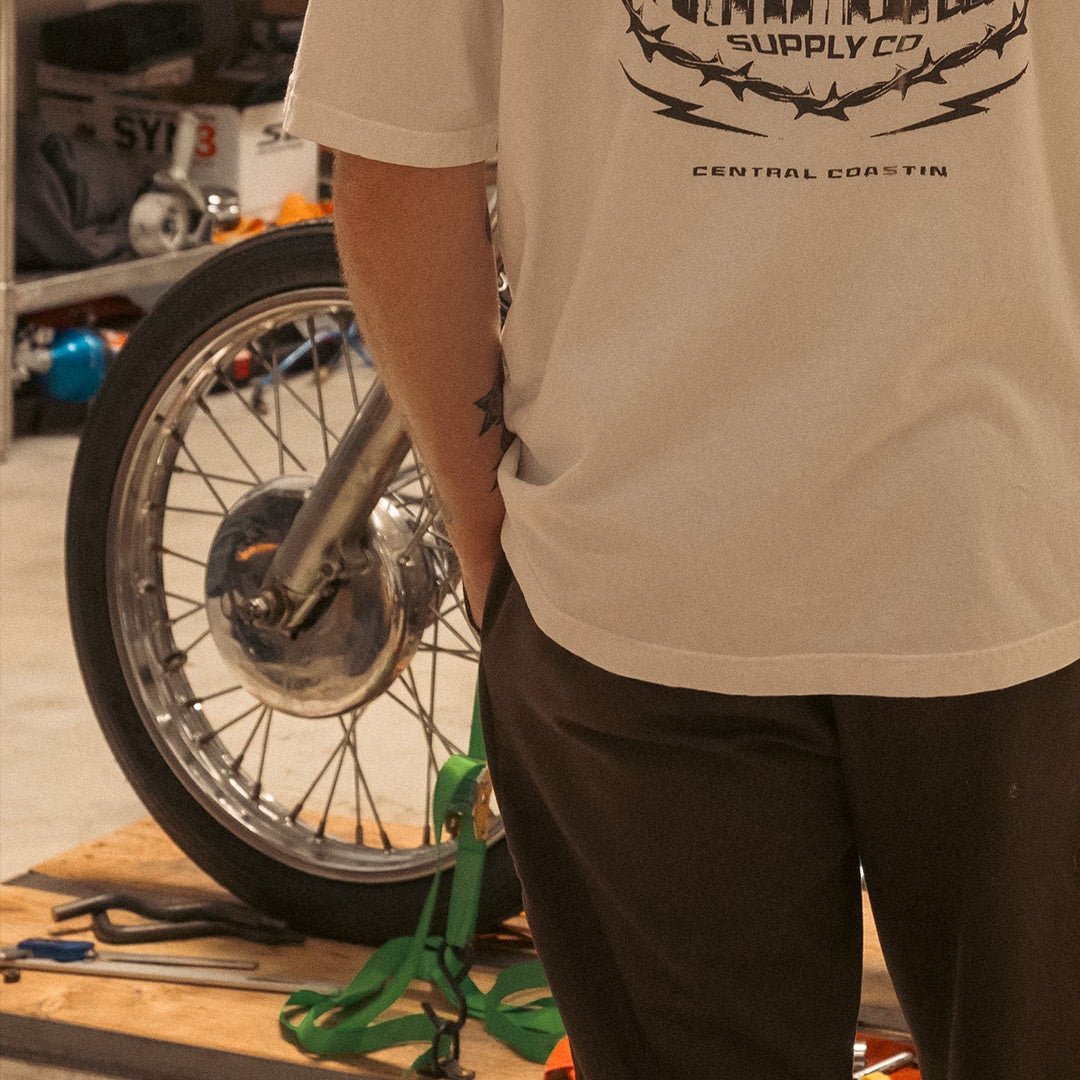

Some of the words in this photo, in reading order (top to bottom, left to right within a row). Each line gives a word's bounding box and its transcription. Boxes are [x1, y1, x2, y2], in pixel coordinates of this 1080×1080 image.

[726, 33, 868, 59] SUPPLY
[872, 34, 924, 58] CO
[692, 165, 817, 180] CENTRAL
[827, 165, 948, 180] COASTIN
